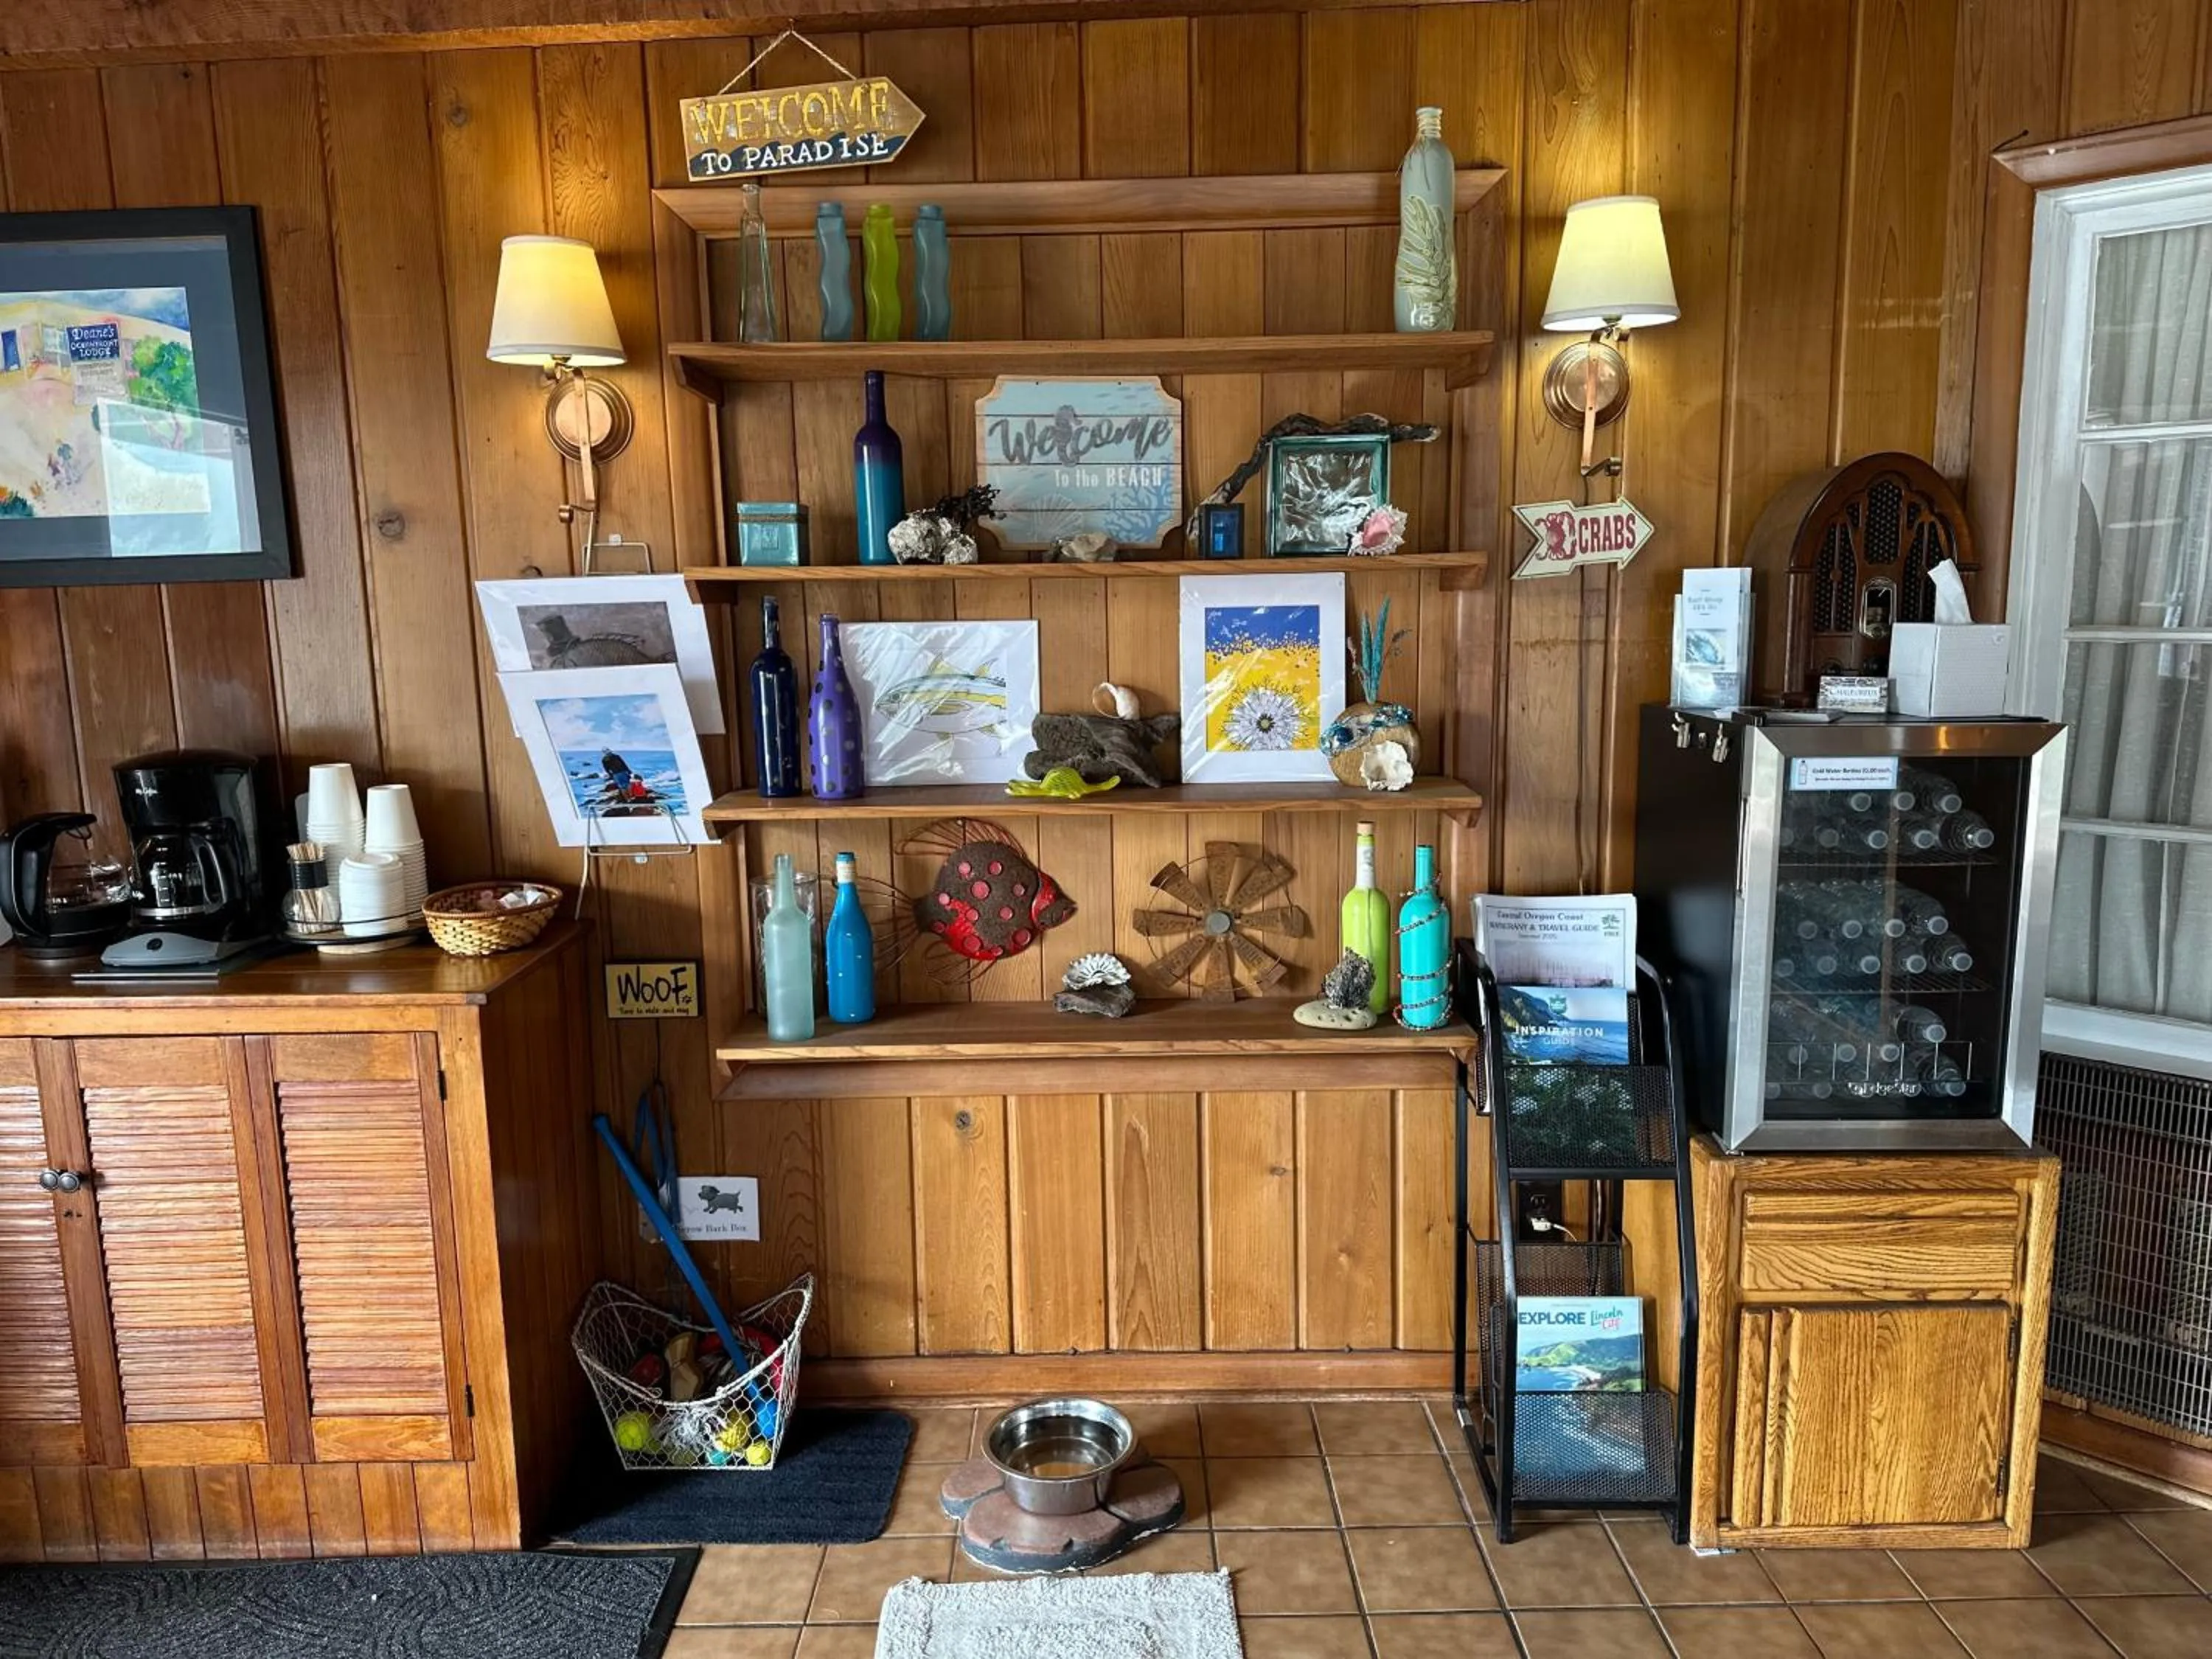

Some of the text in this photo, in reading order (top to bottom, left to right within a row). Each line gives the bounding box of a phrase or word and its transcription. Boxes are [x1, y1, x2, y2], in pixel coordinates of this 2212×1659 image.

[691, 82, 892, 143] WELCOME
[744, 133, 888, 170] PARADISE
[80, 347, 111, 358] LODGE
[1076, 470, 1098, 487] the
[1106, 466, 1161, 487] BEACH
[1579, 512, 1636, 554] CRABS
[1524, 911, 1555, 921] Oregon
[1514, 1026, 1604, 1037] INSPIRATION
[1519, 1312, 1586, 1325] EXPLORE
